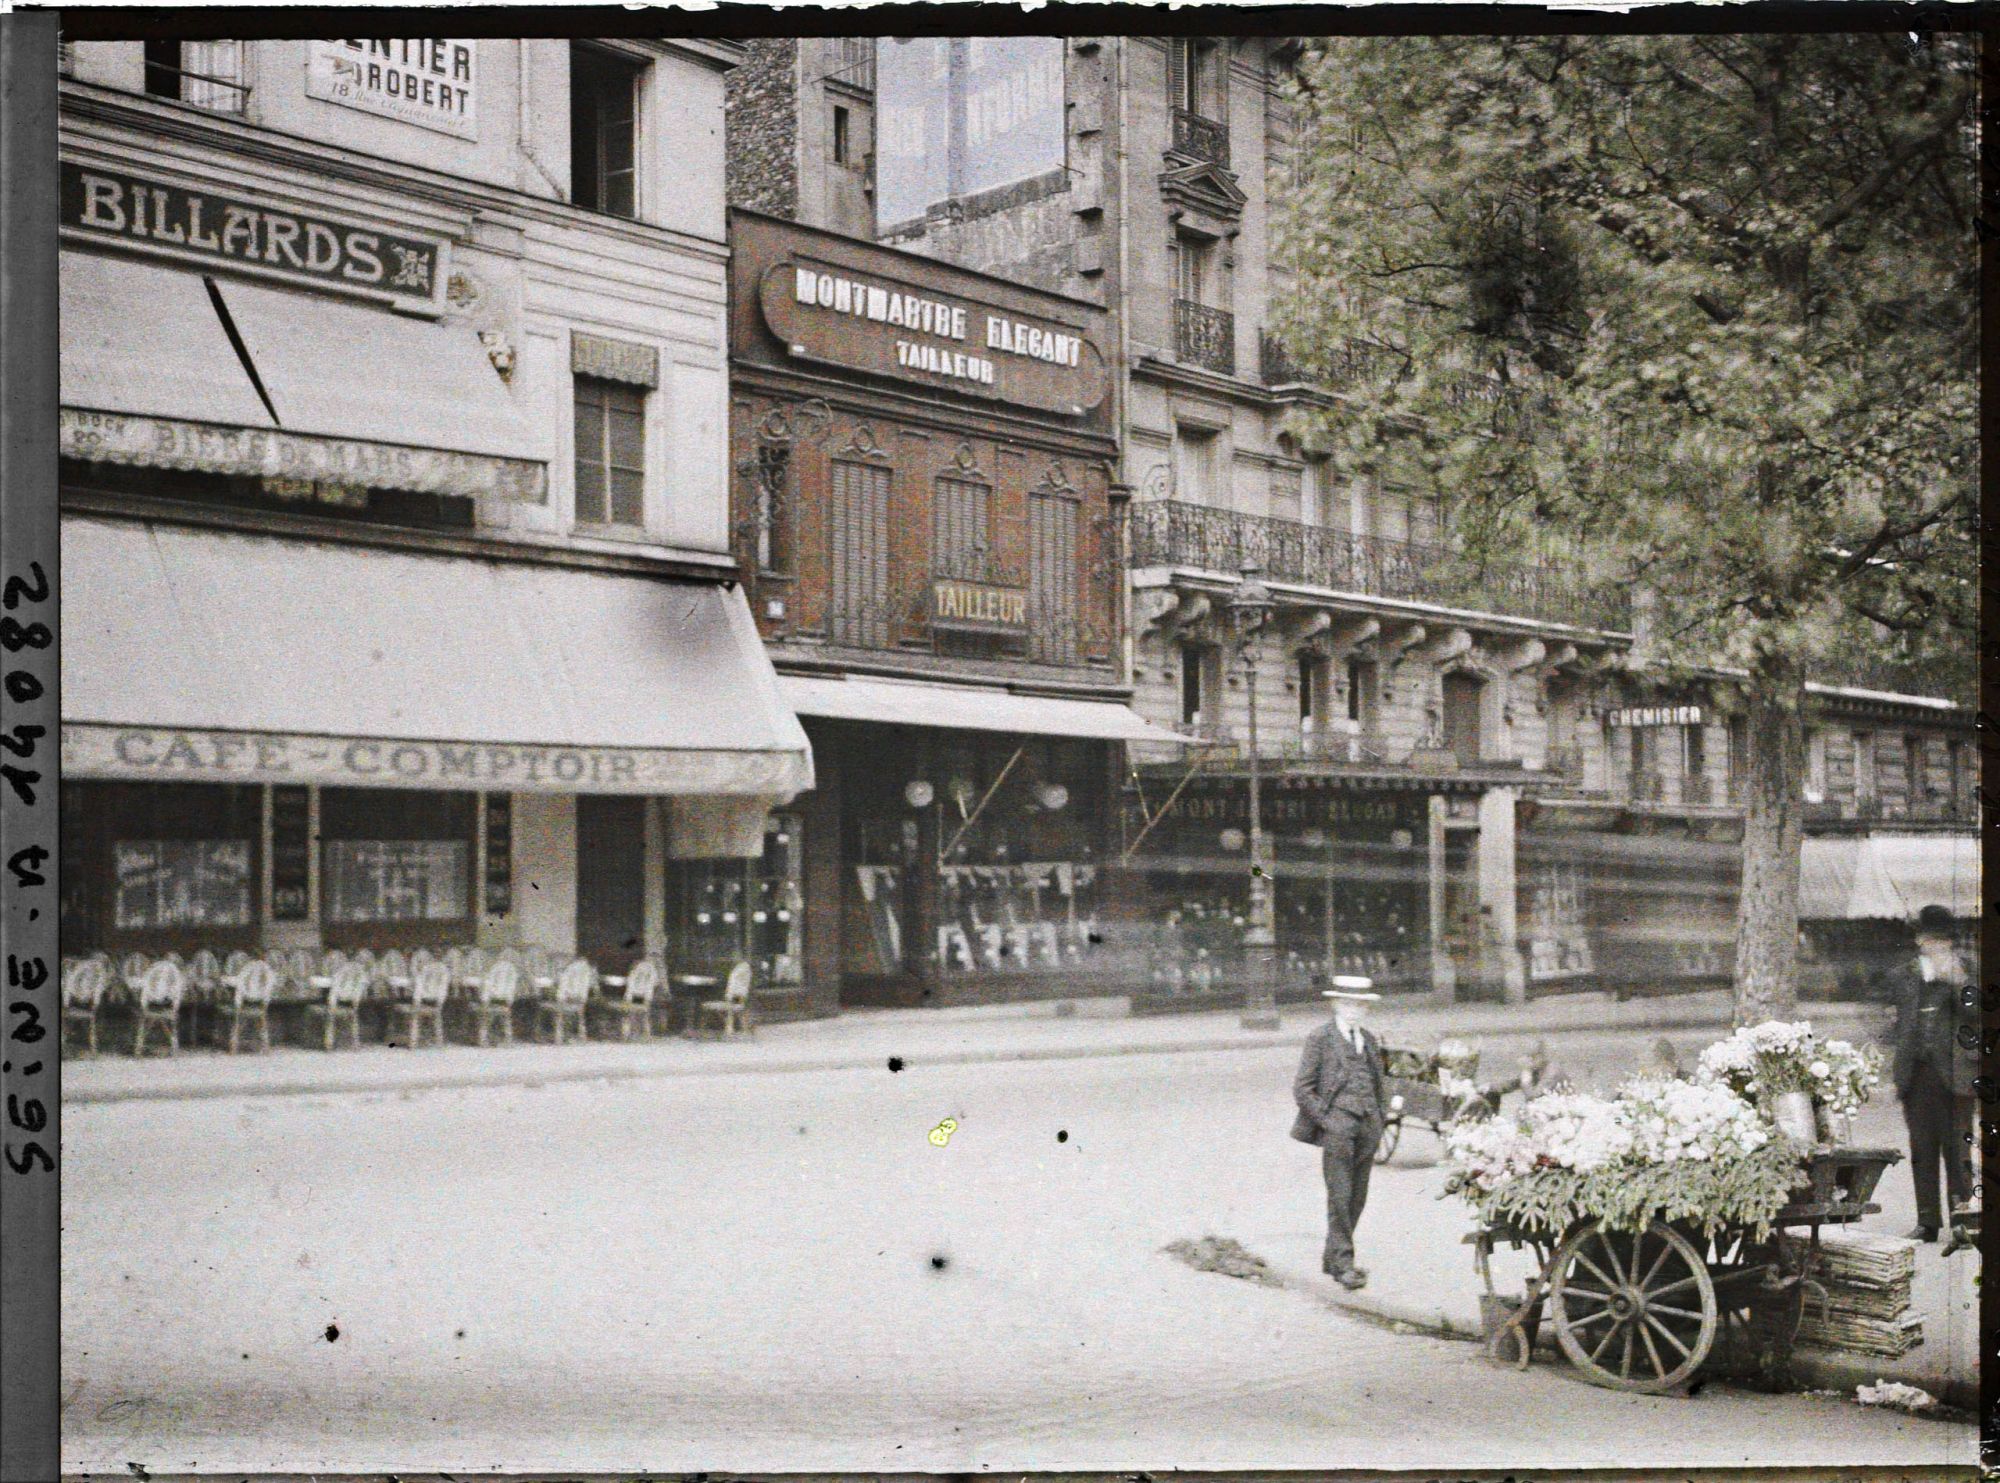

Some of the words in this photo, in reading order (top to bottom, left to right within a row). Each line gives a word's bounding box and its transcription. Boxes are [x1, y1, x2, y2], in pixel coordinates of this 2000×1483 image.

[331, 82, 350, 98] 18
[367, 62, 470, 113] ROBERT
[80, 173, 385, 284] BILLARDS
[796, 267, 967, 341] MONTMARTRE
[896, 340, 994, 385] TAILLEUR
[935, 584, 1026, 625] TAILLEUR
[0, 561, 52, 807] 14082
